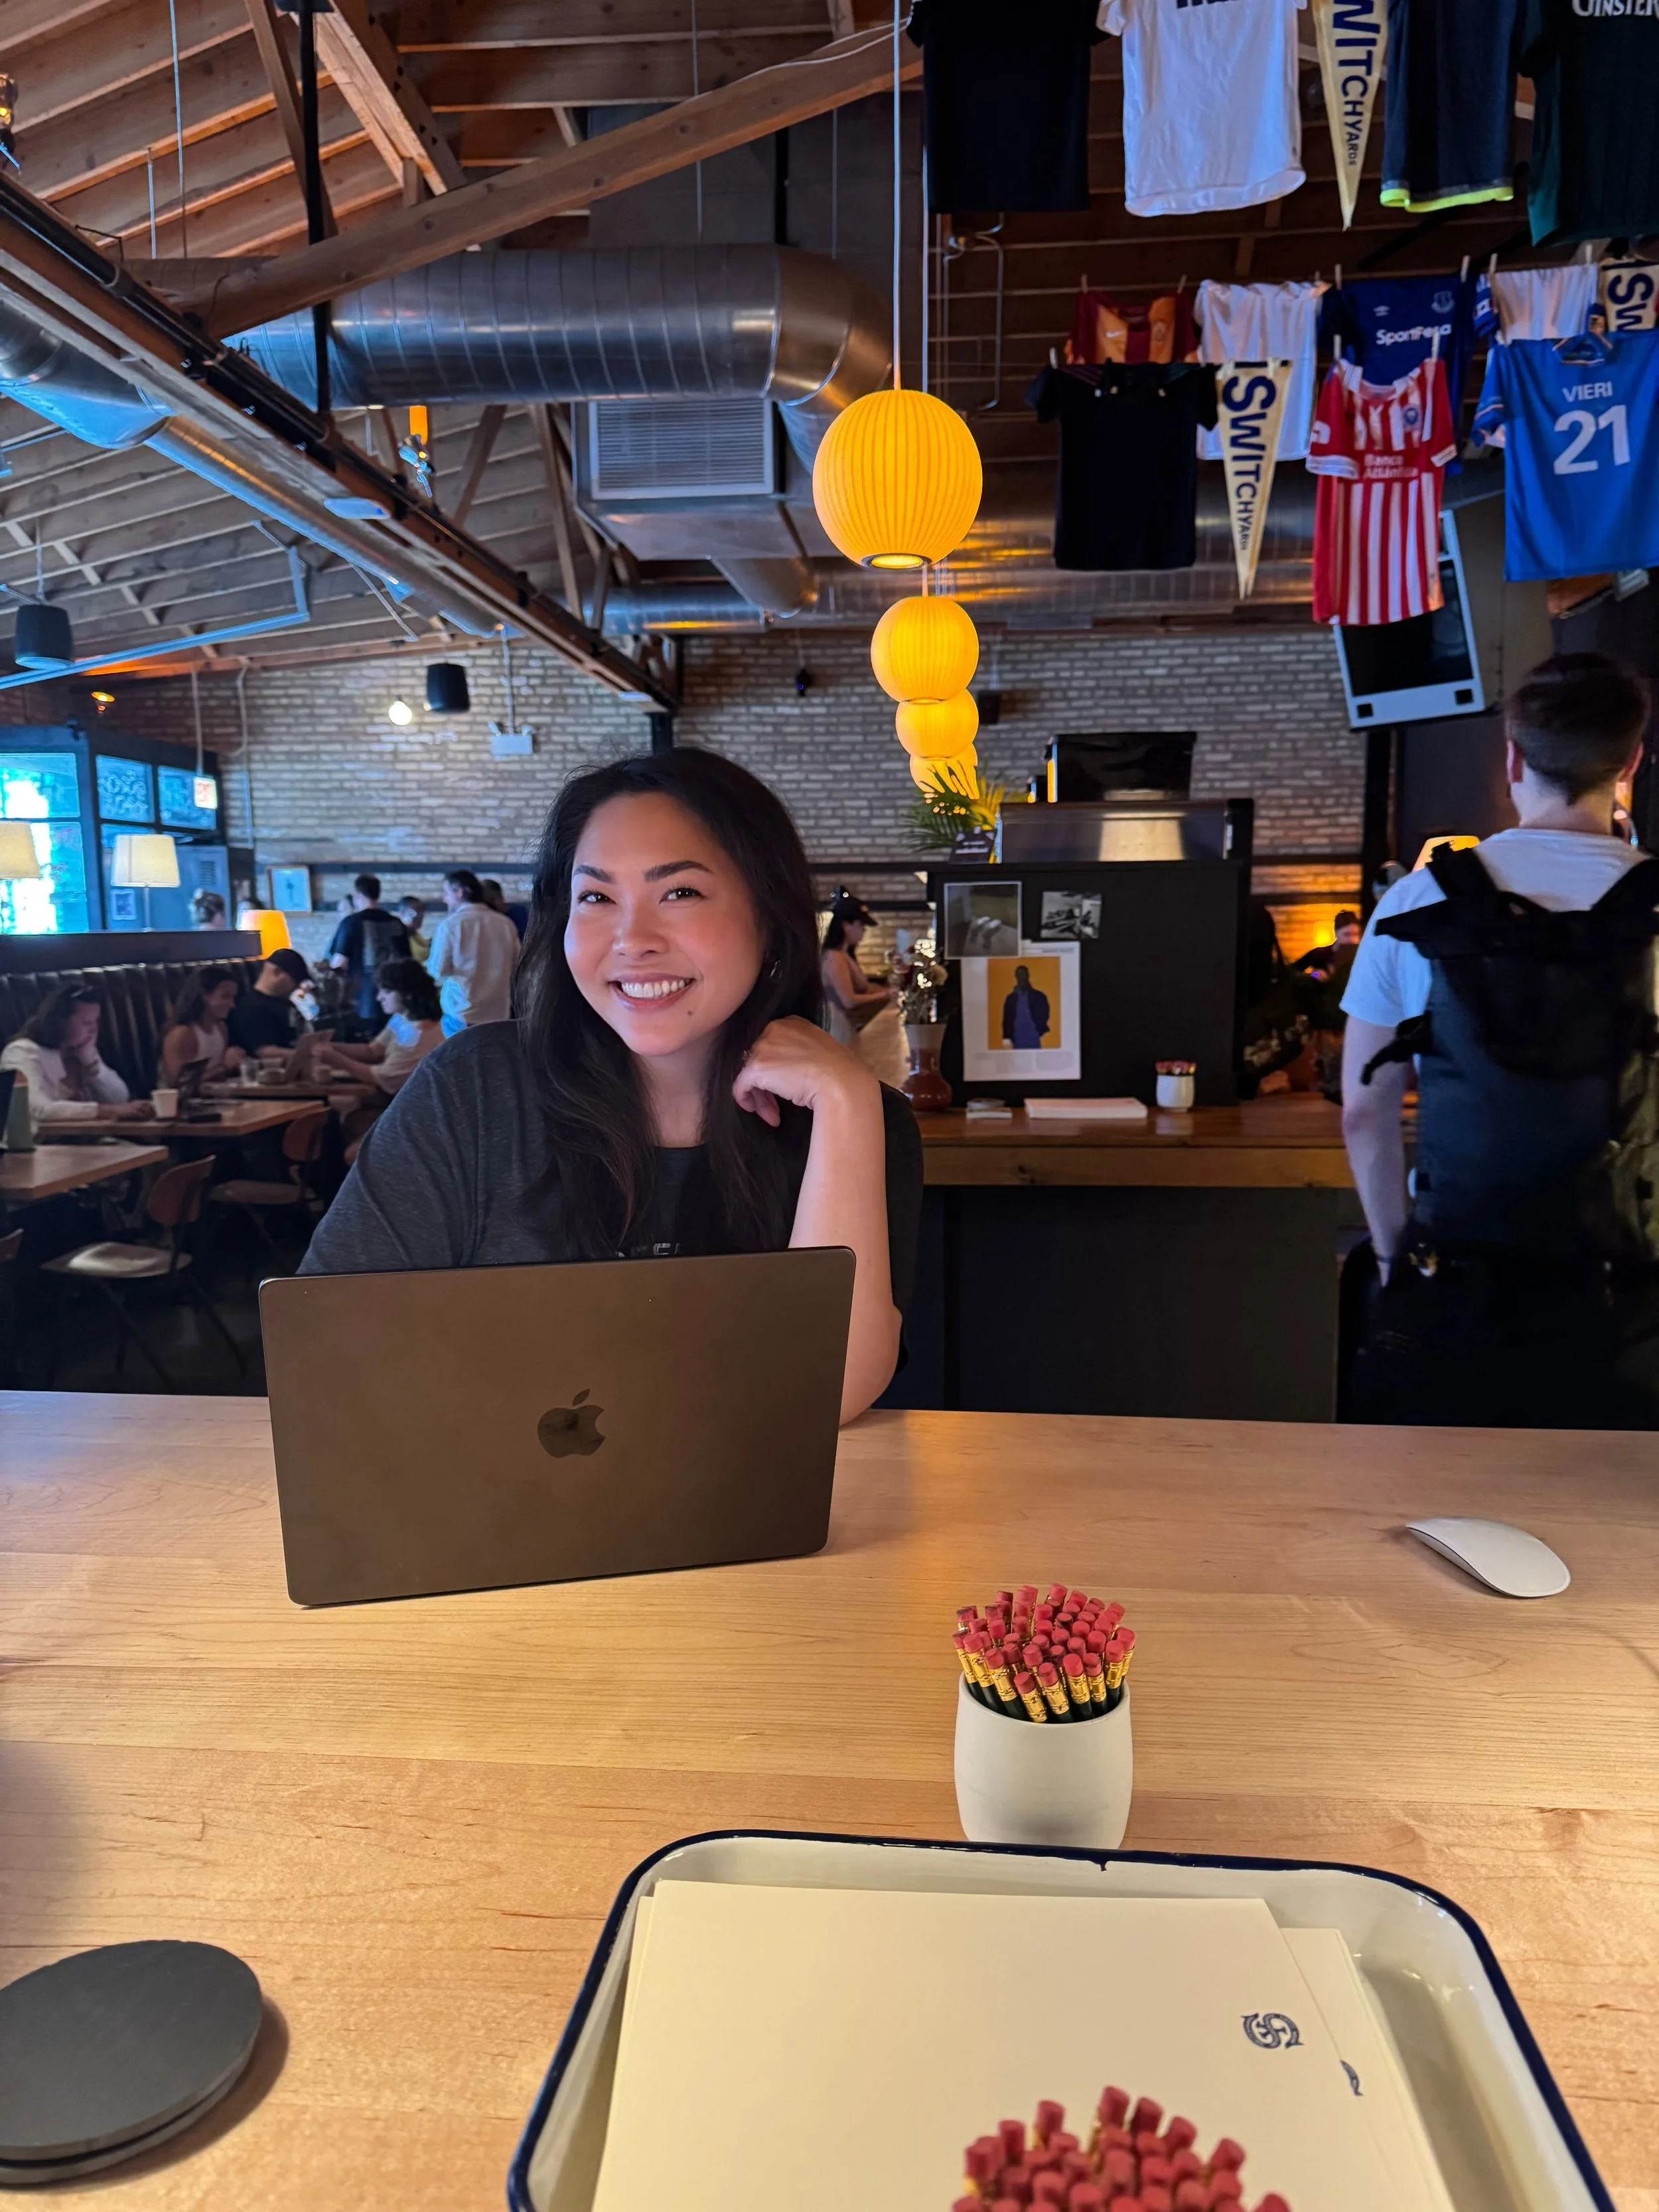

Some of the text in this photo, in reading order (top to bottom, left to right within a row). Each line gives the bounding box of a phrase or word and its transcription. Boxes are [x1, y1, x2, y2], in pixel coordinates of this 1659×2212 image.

[1333, 0, 1381, 166] WITCHYARDS
[1561, 381, 1613, 402] VIERI
[1553, 404, 1630, 475] 21
